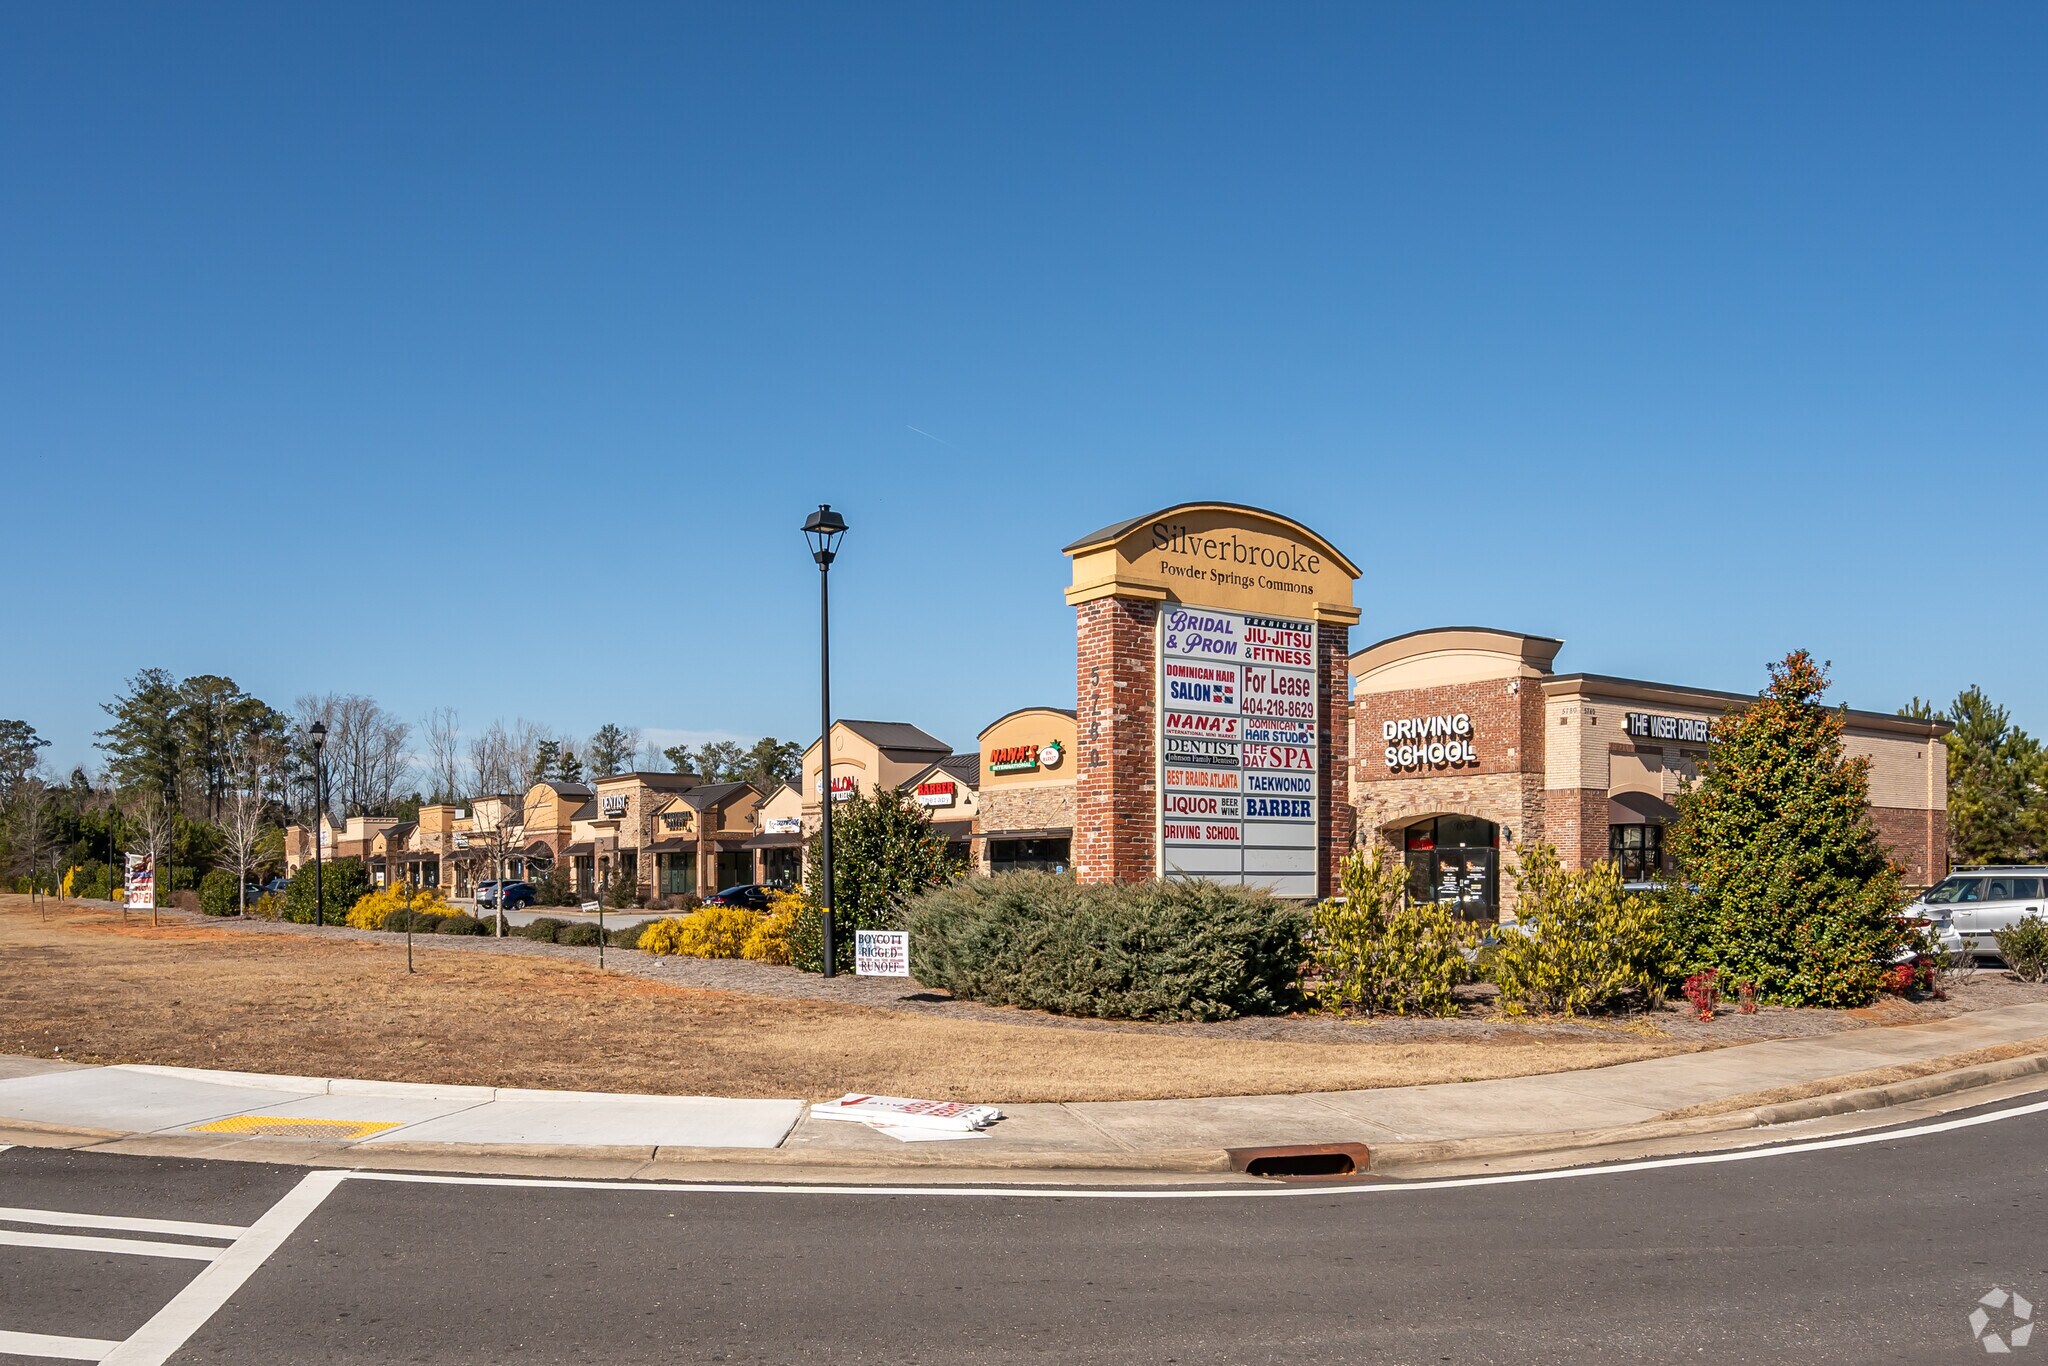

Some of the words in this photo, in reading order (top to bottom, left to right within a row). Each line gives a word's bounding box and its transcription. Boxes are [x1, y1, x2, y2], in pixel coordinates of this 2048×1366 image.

[1152, 523, 1320, 574] Silverbrooke
[1161, 561, 1207, 580] Powder
[1210, 568, 1254, 589] Springs
[1258, 575, 1313, 595] Commons
[1167, 611, 1233, 635] BRIDAL
[1166, 634, 1178, 649] &
[1182, 633, 1238, 655] PROM
[1244, 627, 1312, 649] JIU-JITSU
[1166, 664, 1214, 681] DOMINICAN
[1216, 669, 1235, 683] HAIR
[1245, 667, 1266, 693] For
[1271, 669, 1310, 697] Lease
[1171, 681, 1211, 702] SALON
[1242, 697, 1314, 718] 404-218-8629
[1166, 713, 1238, 733] NANA'S
[1249, 719, 1296, 731] DOMINICAN
[1383, 713, 1470, 740] DRIVING
[1630, 713, 1648, 735] THE
[1650, 715, 1677, 739] WISER
[1678, 718, 1708, 742] DRIVER
[1166, 729, 1204, 737] INTERNATIONAL
[1245, 729, 1270, 741] HAIR
[1272, 731, 1309, 744] STUDIO
[990, 745, 1037, 762] NANA'S
[1168, 739, 1238, 755] DENTIST
[1243, 743, 1267, 754] LIFE
[1384, 740, 1476, 767] SCHOOL
[1168, 753, 1191, 762] Johnson
[1192, 754, 1211, 764] Family
[1212, 756, 1239, 767] Dentistry
[1243, 755, 1267, 768] DAY
[1269, 746, 1313, 769] SPA
[831, 776, 855, 792] ALON
[1167, 770, 1183, 785] BEST
[1185, 770, 1208, 787] BRAIDS
[1210, 773, 1238, 788] ATLANTA
[1248, 776, 1311, 792] TAEKWONDO
[917, 782, 954, 796] BARBER
[602, 794, 625, 810] DENTIST
[1164, 794, 1217, 814] LIQUOR
[1221, 798, 1238, 806] BEER
[1246, 798, 1311, 817] BARBER
[1221, 807, 1239, 816] WINE
[1164, 824, 1201, 839] DRIVING
[1206, 825, 1239, 840] SCHOOL
[858, 933, 902, 944] BOYCOTT
[861, 947, 897, 958] RIGGED
[861, 960, 899, 973] RUNOFF
